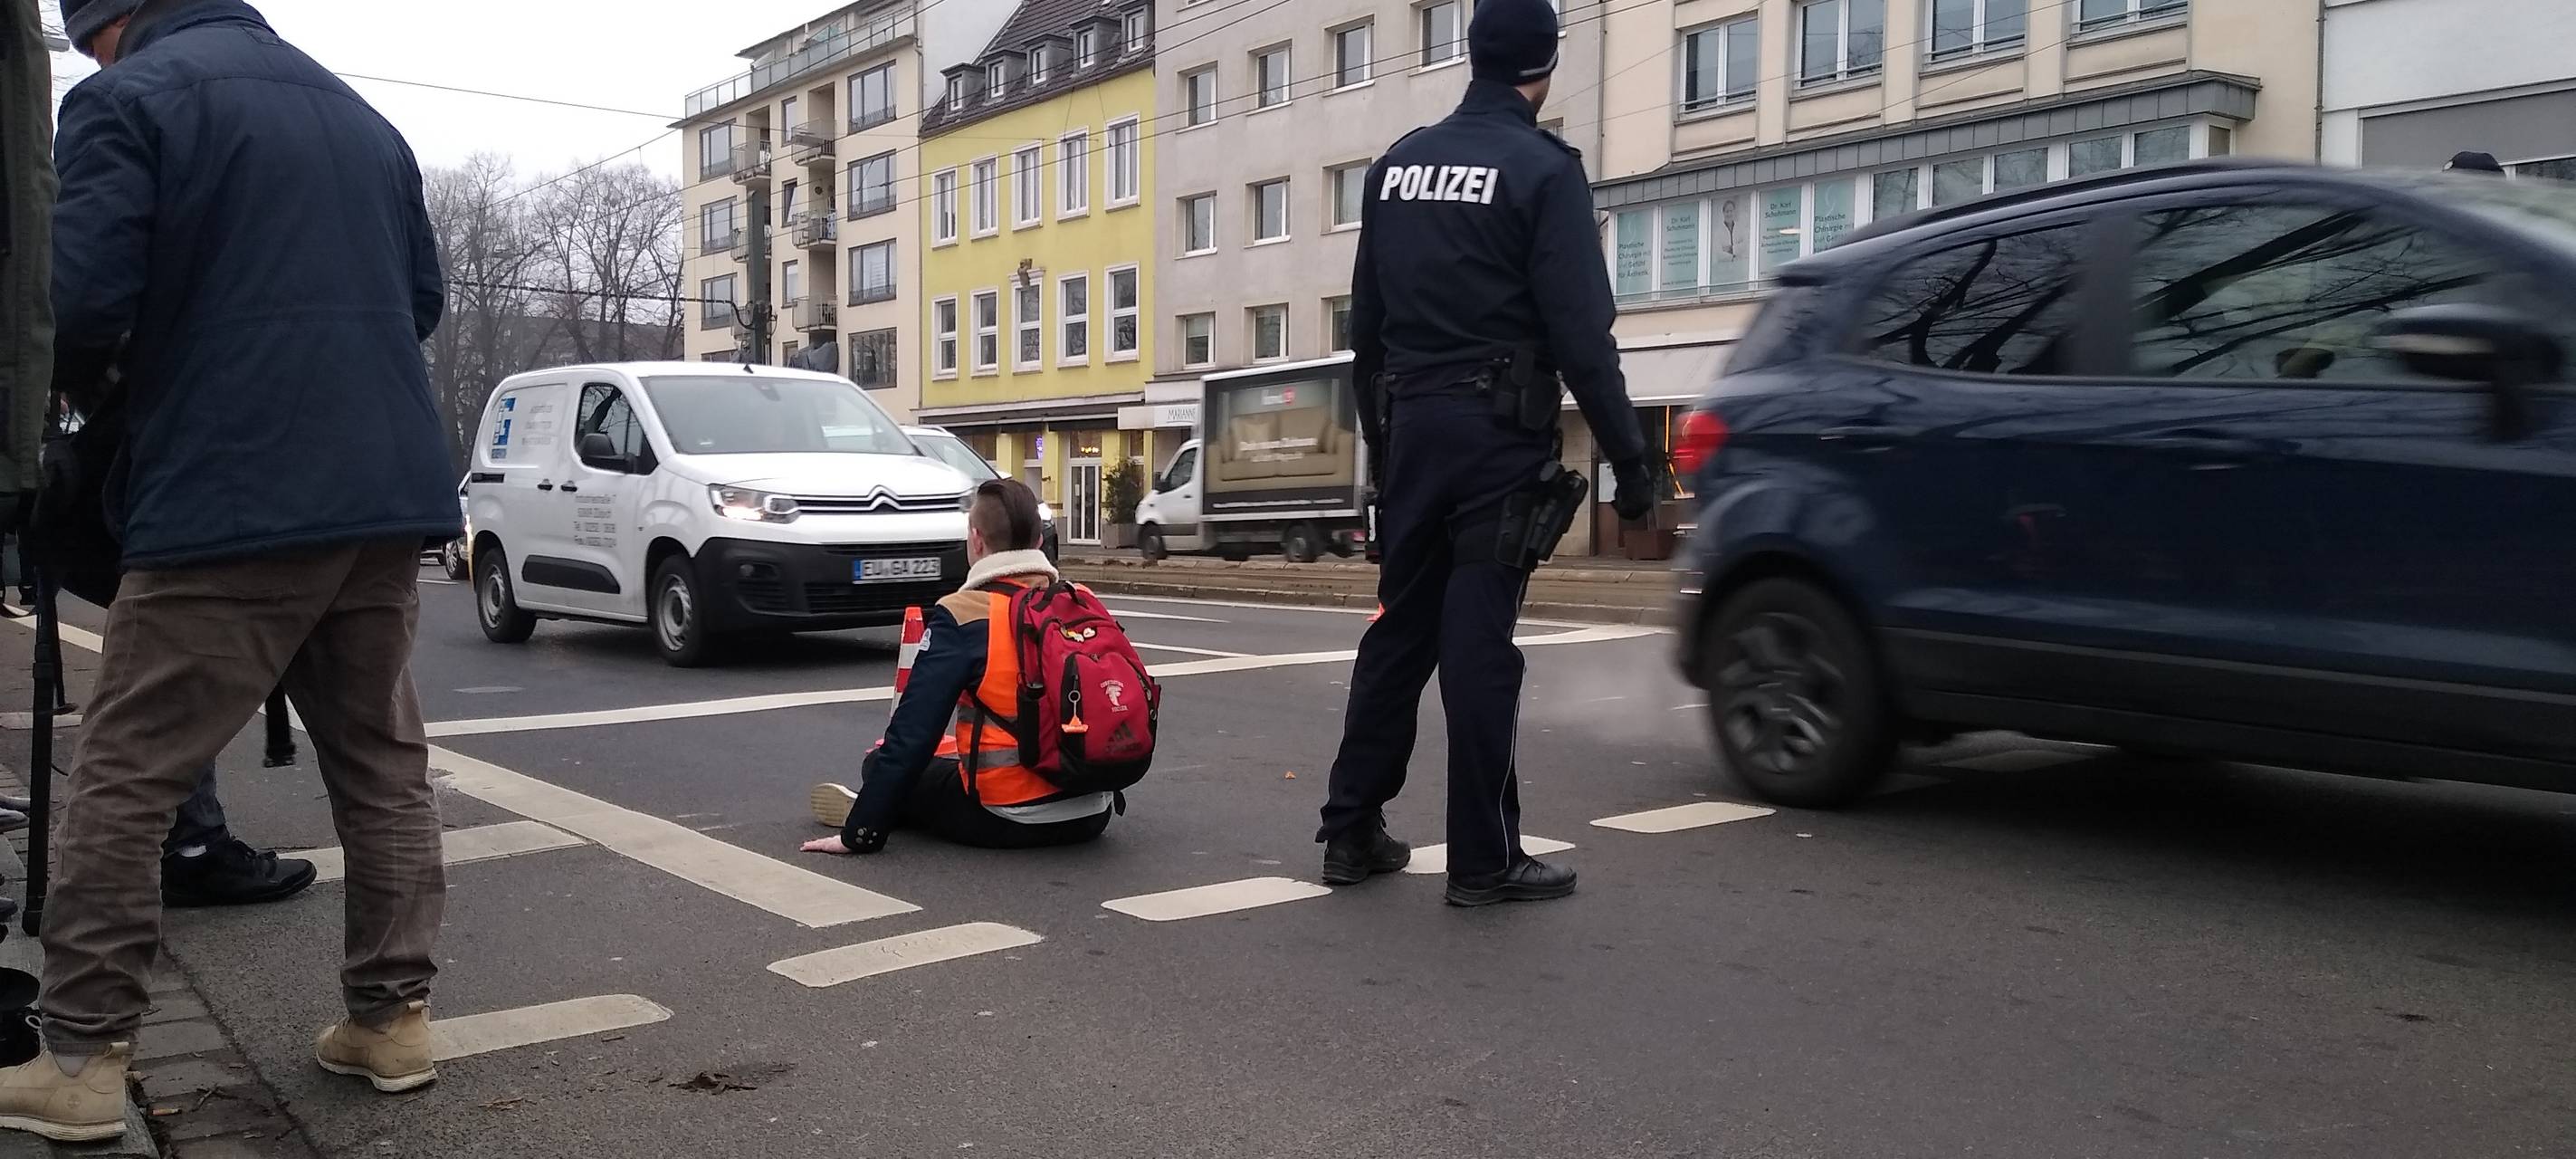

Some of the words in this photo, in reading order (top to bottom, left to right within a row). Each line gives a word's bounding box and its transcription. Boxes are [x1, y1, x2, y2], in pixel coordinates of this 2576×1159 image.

[1379, 164, 1499, 205] POLIZEI
[1814, 213, 1846, 222] Plastische
[1814, 224, 1843, 234] Chirurgie
[863, 561, 882, 577] EU
[891, 560, 910, 576] GA
[912, 559, 939, 575] 223
